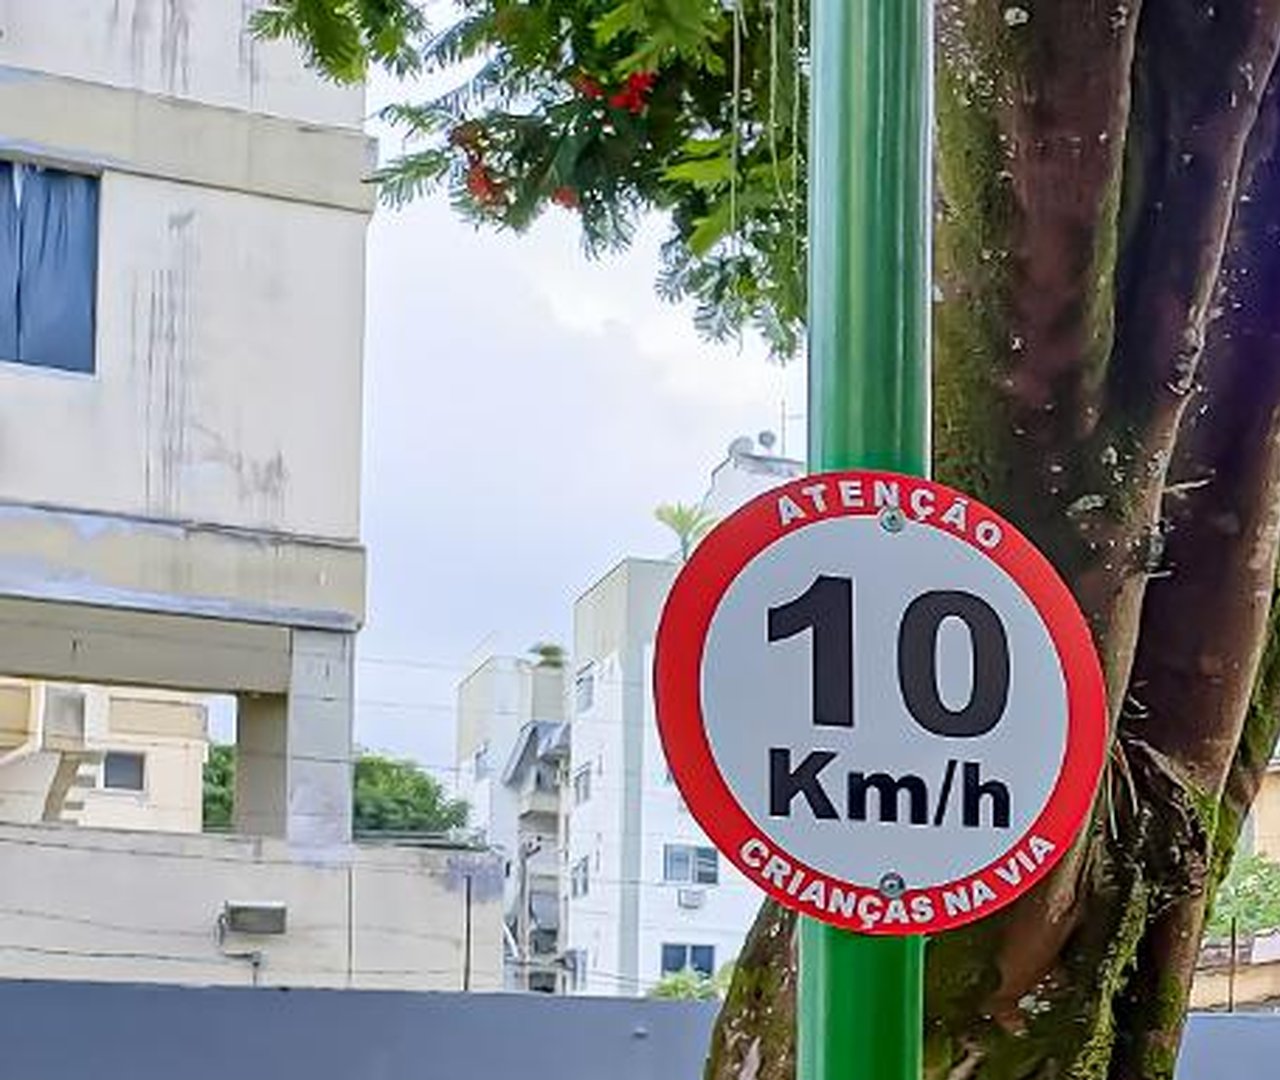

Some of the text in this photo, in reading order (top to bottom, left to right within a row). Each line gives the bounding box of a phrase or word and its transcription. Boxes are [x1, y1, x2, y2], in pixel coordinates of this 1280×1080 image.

[778, 479, 1004, 550] ATENÇÃO
[767, 573, 1011, 739] 10
[768, 747, 1011, 828] Km/h
[738, 834, 1056, 929] CRIANÇAS NA VIA
